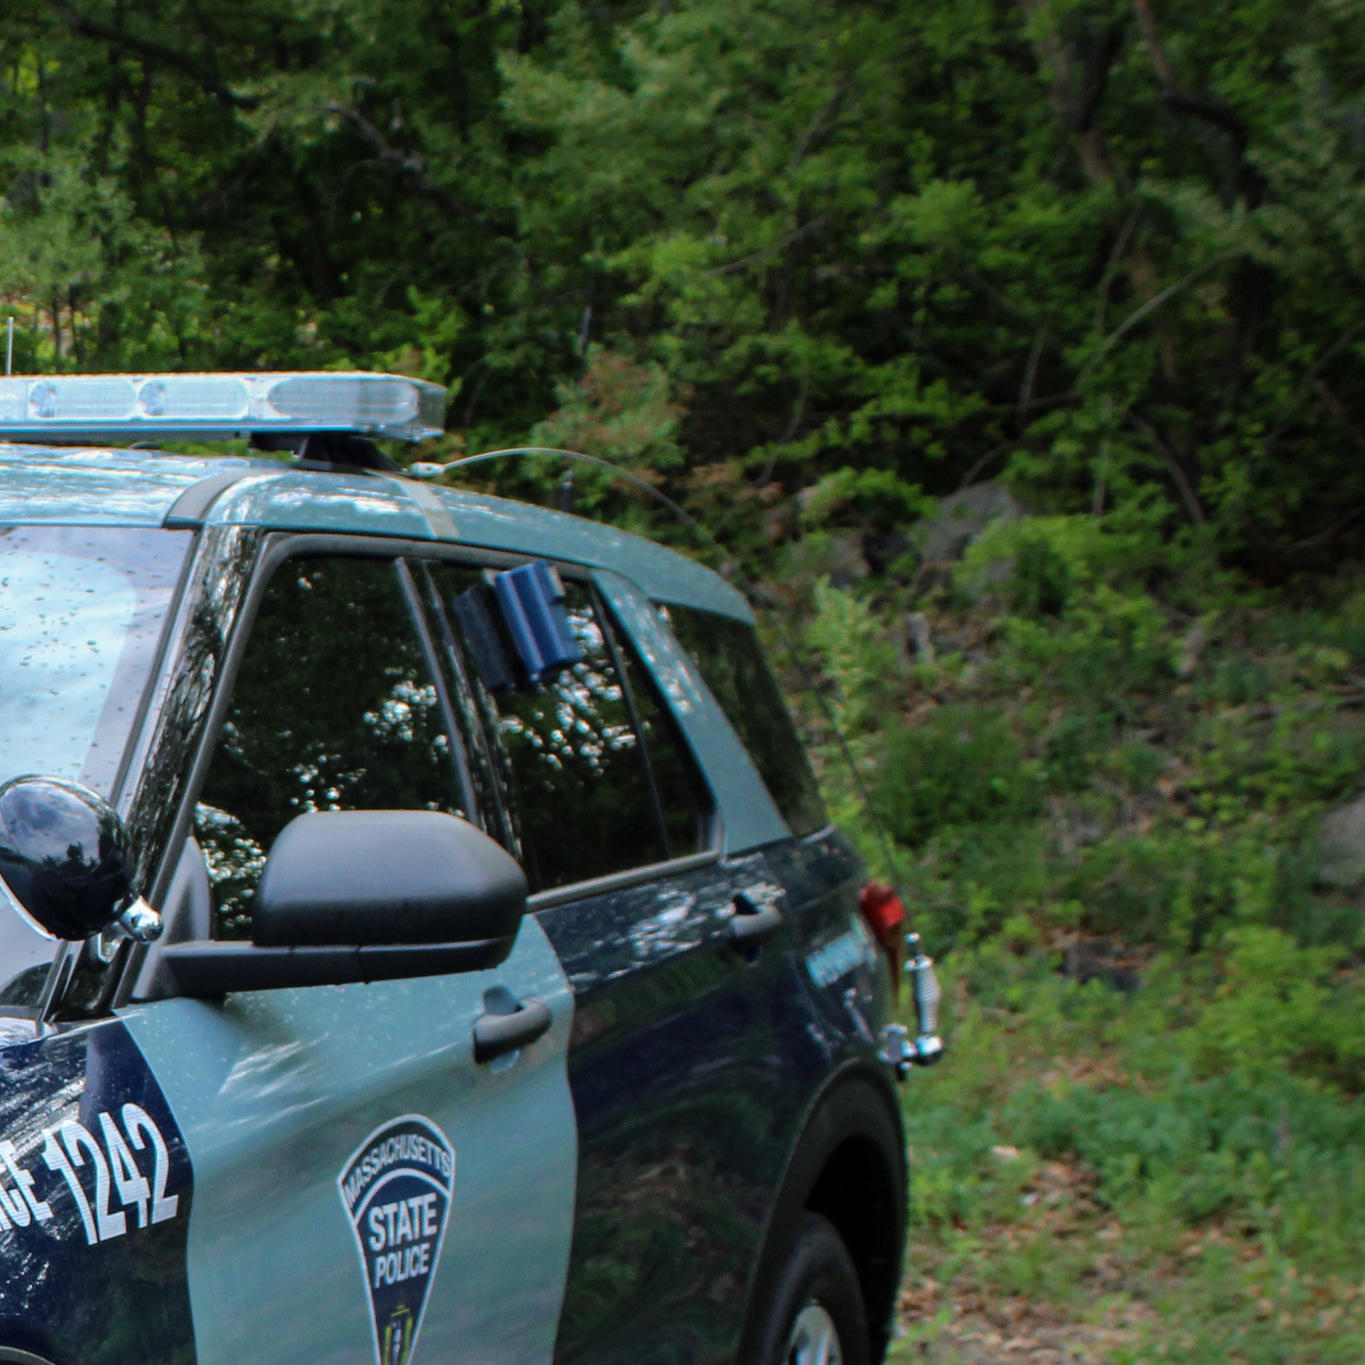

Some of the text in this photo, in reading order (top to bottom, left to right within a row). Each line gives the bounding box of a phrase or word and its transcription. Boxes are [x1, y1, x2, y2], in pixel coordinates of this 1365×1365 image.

[41, 1102, 180, 1246] 1242
[343, 1133, 452, 1208] MASSACHUSETTS
[369, 1192, 437, 1252] STATE
[375, 1244, 431, 1288] POLICE
